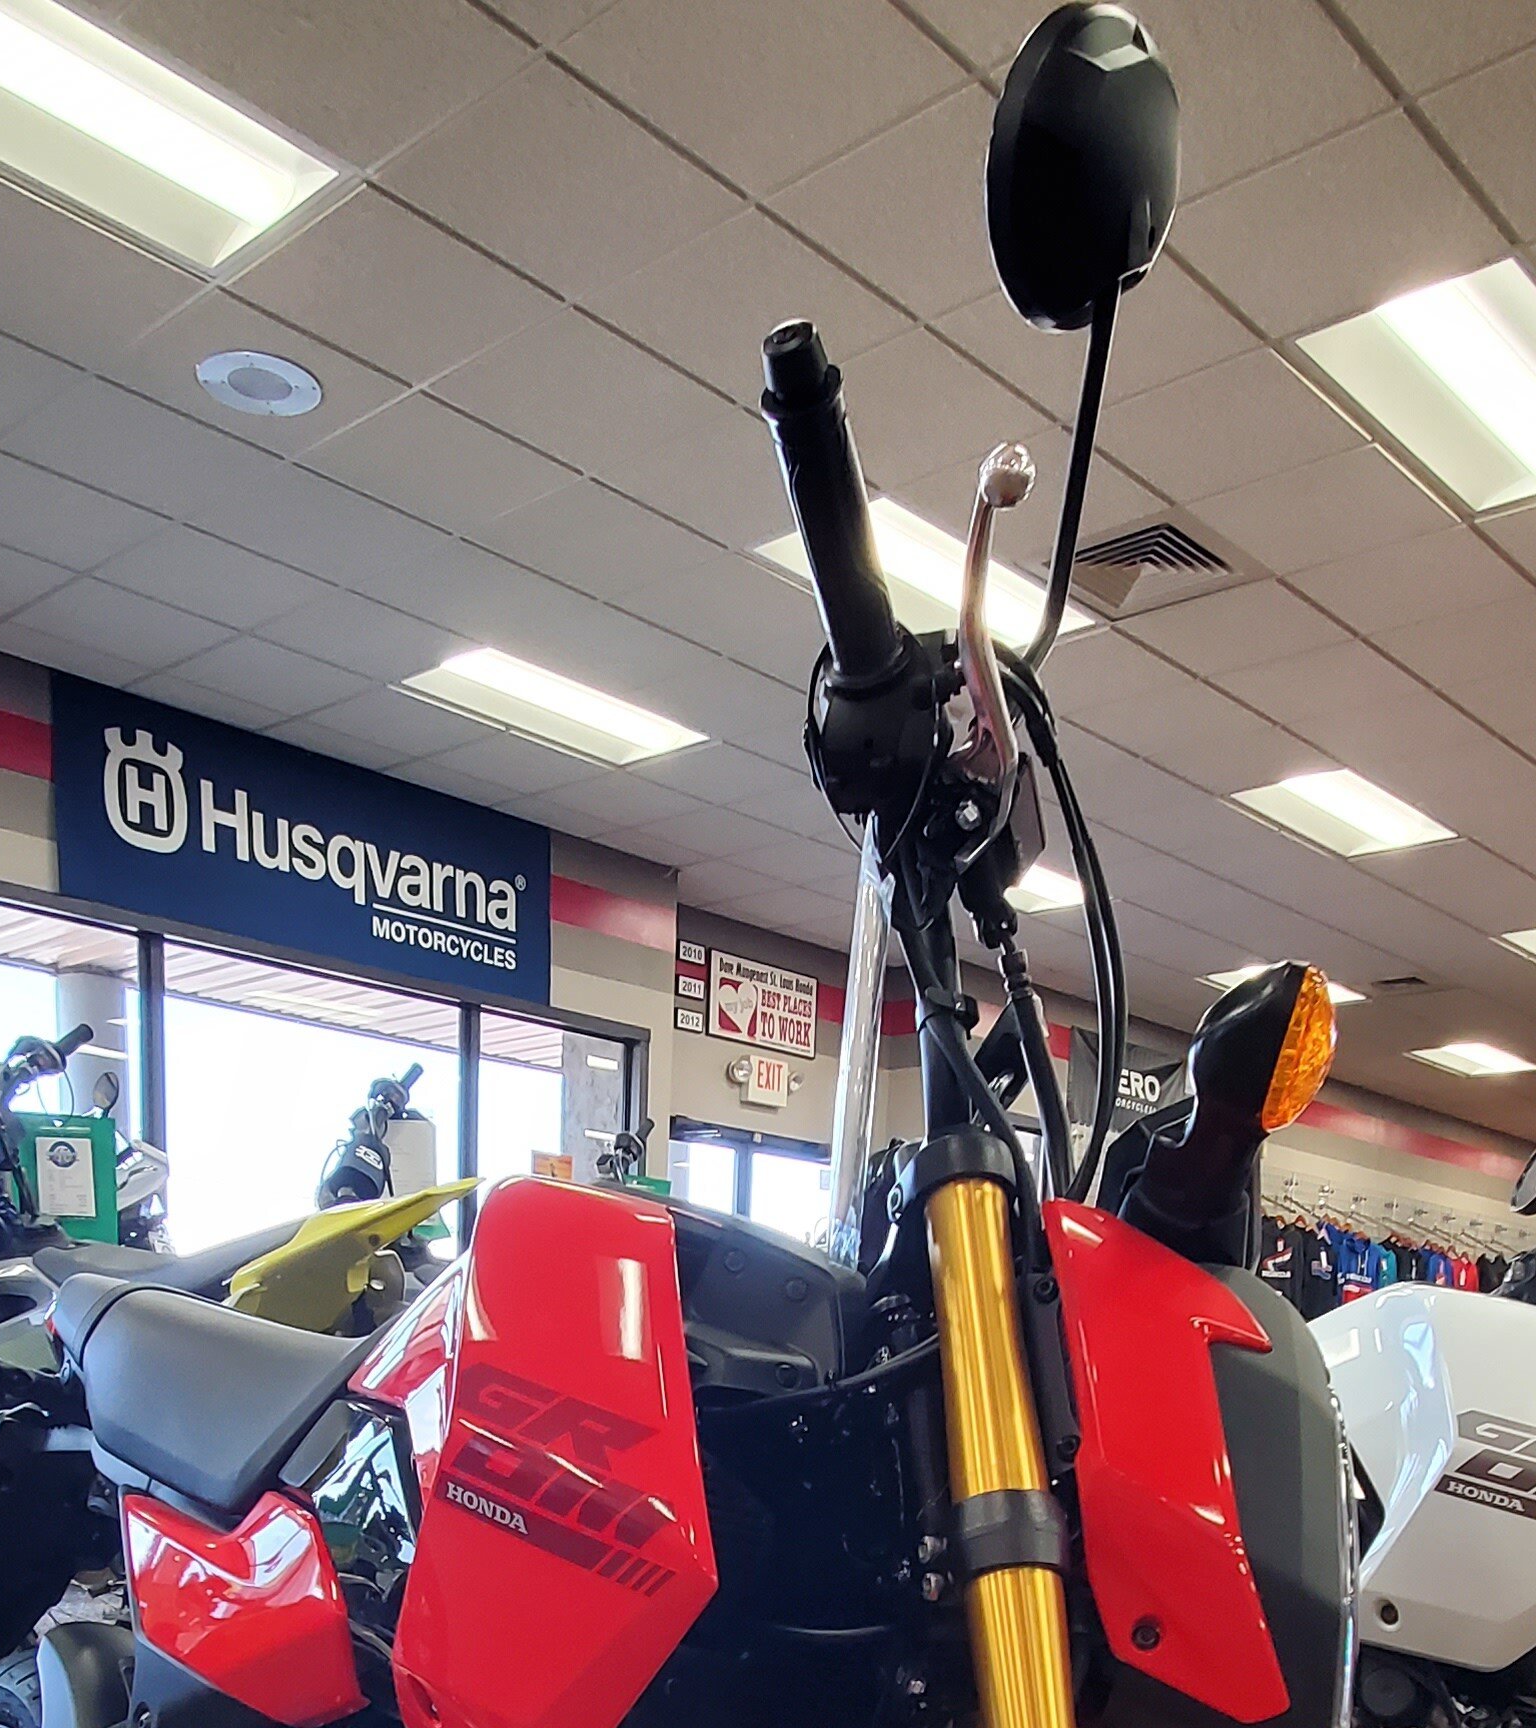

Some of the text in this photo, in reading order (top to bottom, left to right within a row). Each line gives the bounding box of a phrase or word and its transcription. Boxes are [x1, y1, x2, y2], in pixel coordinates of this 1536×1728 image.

[372, 915, 517, 970] MOTORCYCLES
[682, 946, 703, 961] 2010
[682, 981, 702, 995] 2011
[761, 989, 812, 1019] BEST PLACES
[680, 1013, 700, 1027] 2012
[761, 1011, 775, 1039] TO
[779, 1015, 812, 1048] WORK
[757, 1059, 783, 1092] EXIT
[1118, 1068, 1161, 1102] ERO
[446, 1481, 528, 1535] HONDA
[1447, 1481, 1526, 1512] HONDA
